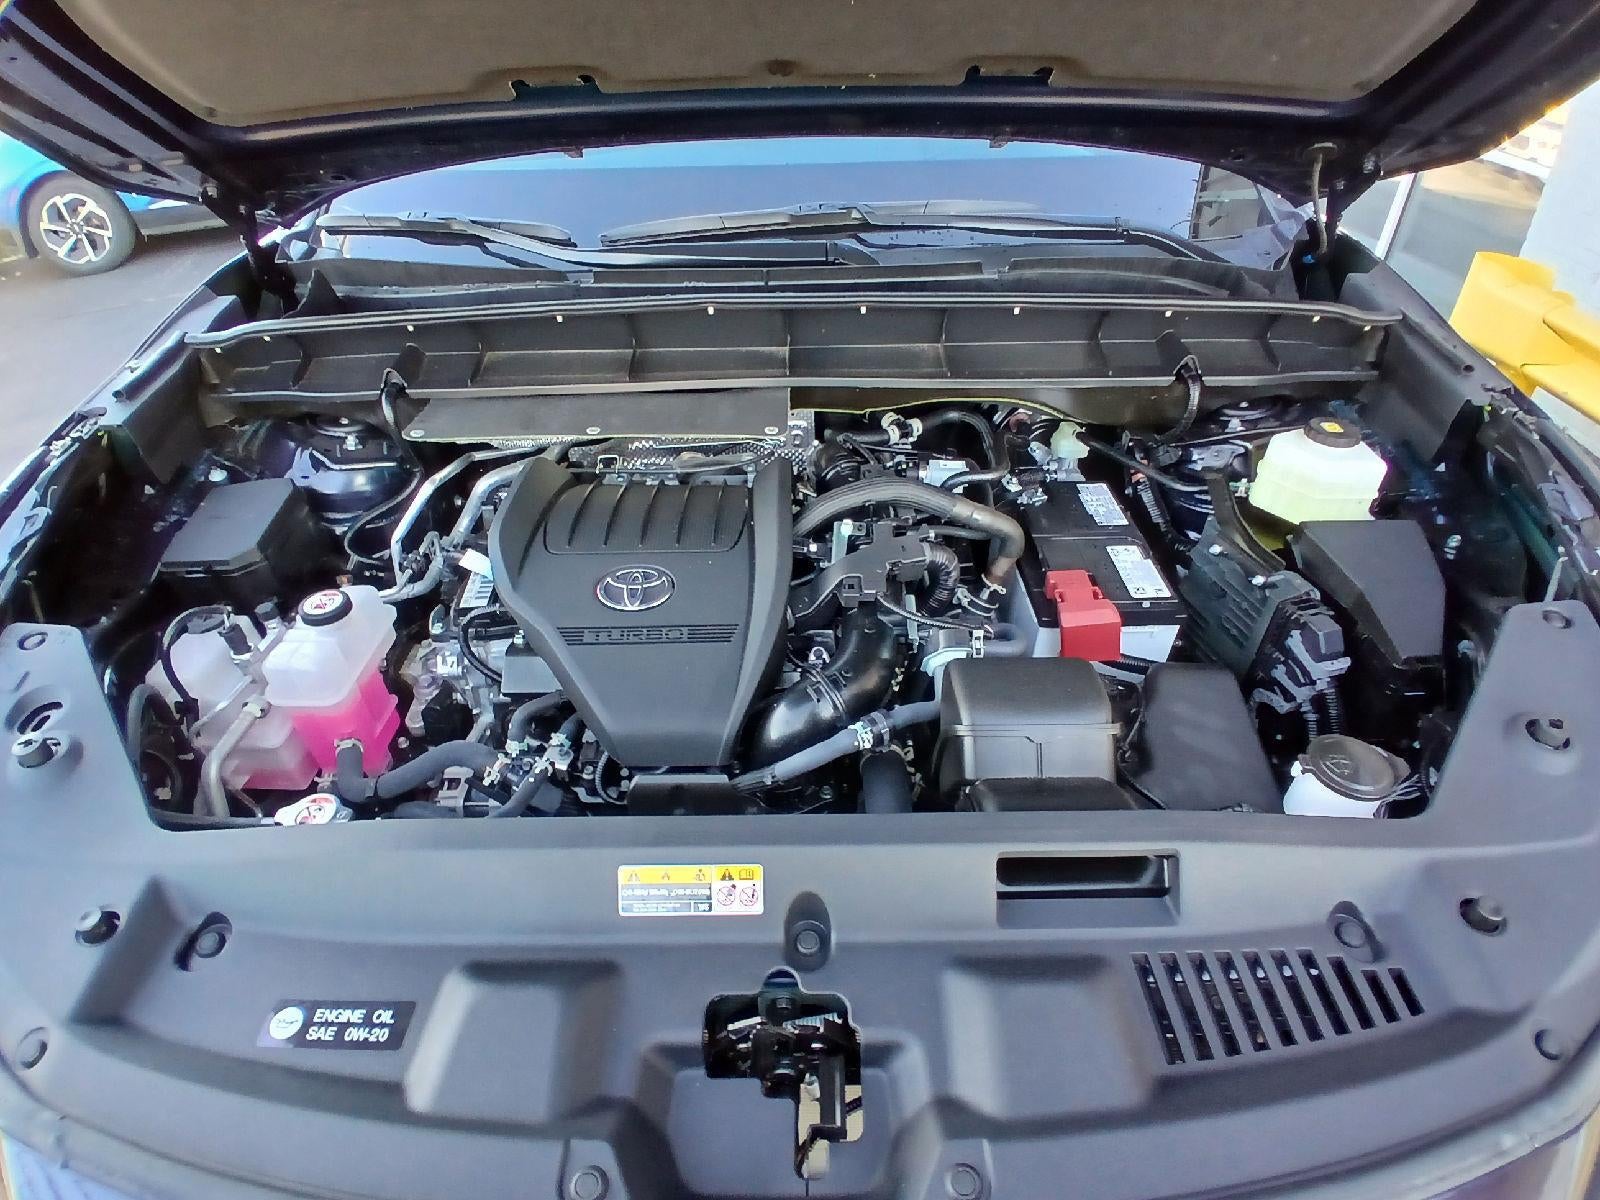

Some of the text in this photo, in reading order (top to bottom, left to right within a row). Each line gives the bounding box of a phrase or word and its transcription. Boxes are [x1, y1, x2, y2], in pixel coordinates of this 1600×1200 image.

[587, 628, 685, 641] TURBO
[312, 1008, 395, 1024] ENGINE OIL
[305, 1026, 390, 1042] SAE 0W-20
